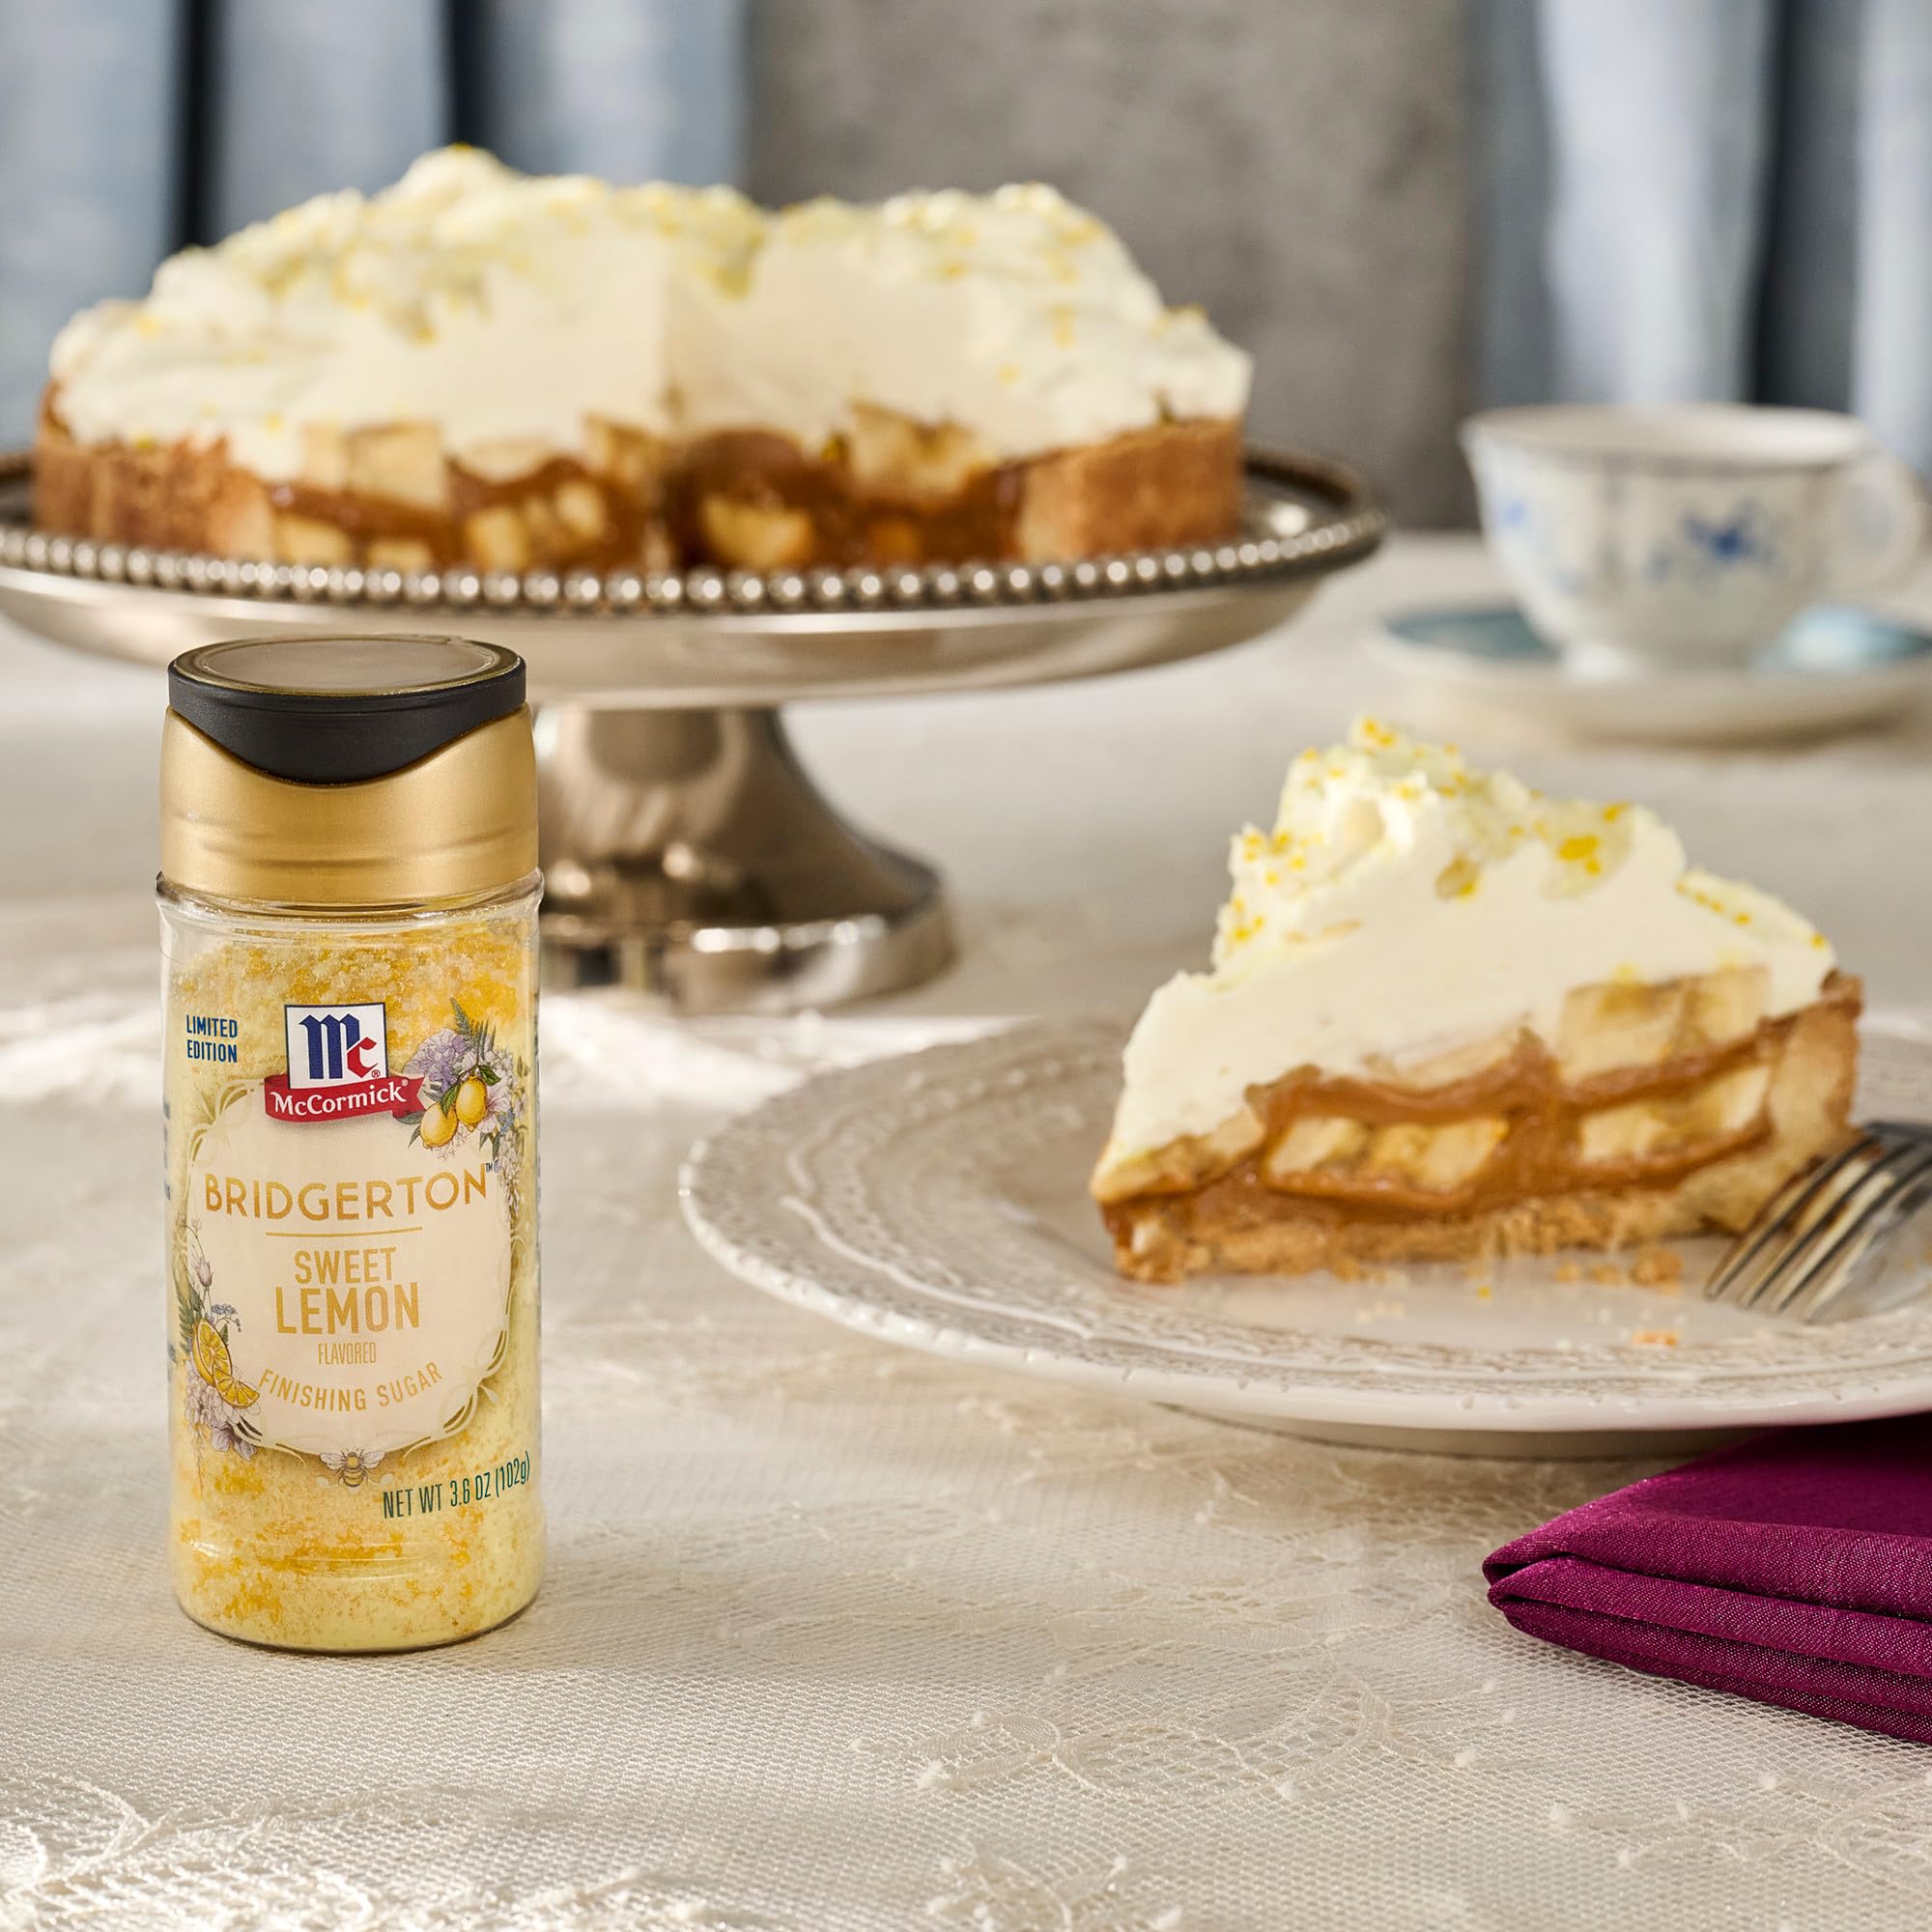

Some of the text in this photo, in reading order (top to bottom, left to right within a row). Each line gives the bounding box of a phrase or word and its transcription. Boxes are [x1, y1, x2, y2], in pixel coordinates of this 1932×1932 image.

[185, 1014, 238, 1038] LIMITED
[186, 1039, 238, 1063] EDITION
[270, 1084, 406, 1117] McCormick
[205, 1164, 487, 1221] BRIDGERTON
[294, 1246, 397, 1285] SWEET
[275, 1282, 420, 1334] LEMON
[318, 1341, 377, 1365] FLAVORED
[259, 1361, 442, 1411] FINISHING SUGAR
[383, 1450, 531, 1519] NET WT 3.6 OZ (102g)
